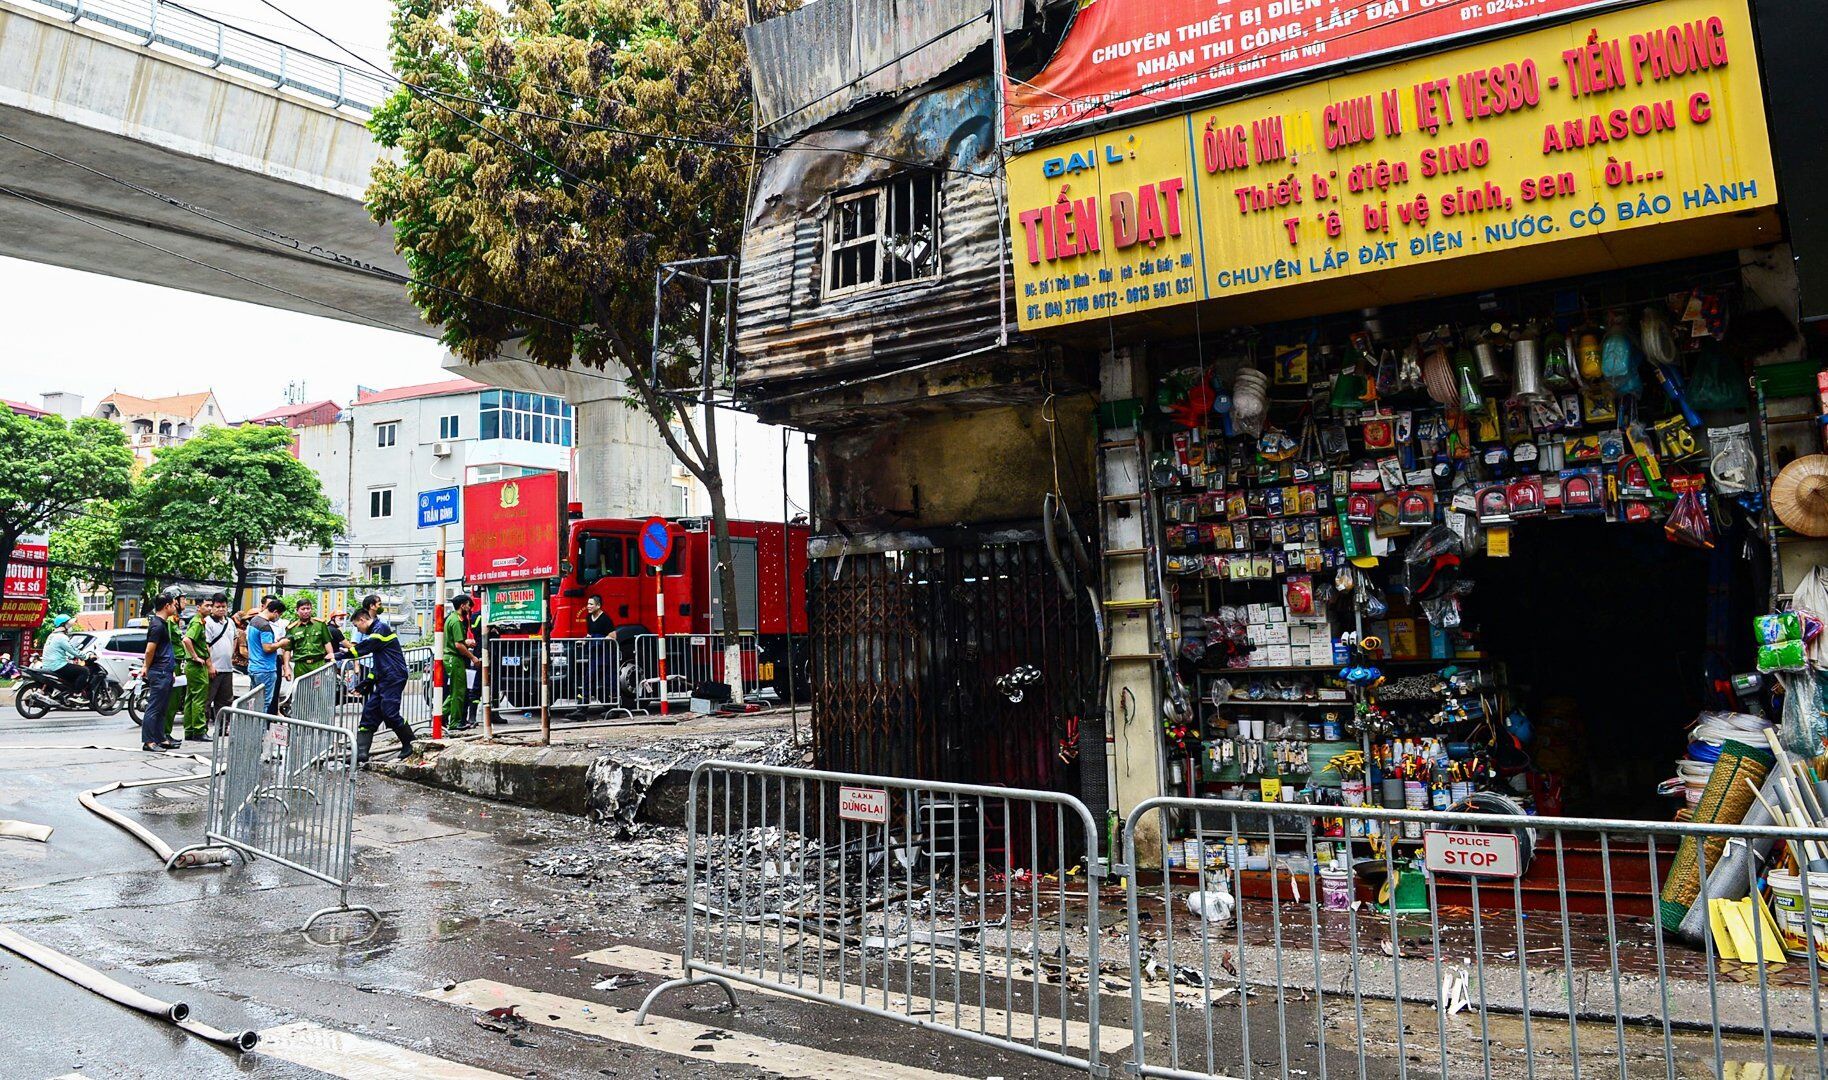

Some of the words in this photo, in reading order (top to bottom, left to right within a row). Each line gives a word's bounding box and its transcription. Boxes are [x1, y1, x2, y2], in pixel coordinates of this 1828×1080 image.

[1091, 32, 1171, 65] CHUYÊN
[1176, 12, 1234, 43] THIẾT
[1240, 7, 1263, 27] BỊ
[1460, 7, 1482, 20] ĐT:
[1136, 50, 1196, 78] NHẬN
[1200, 38, 1235, 61] THI
[1241, 18, 1309, 52] CÔNG,
[1316, 8, 1358, 33] LẮP
[1022, 114, 1041, 126] ĐC:
[1044, 104, 1058, 121] SỐ
[1061, 106, 1068, 116] 1
[1209, 62, 1235, 79] CẦU
[1281, 48, 1299, 62] HÀ
[1303, 42, 1326, 57] NỘI
[1203, 116, 1249, 174] ỐNG
[1458, 58, 1541, 120] VESBO
[1629, 16, 1729, 84] PHONG
[1543, 100, 1676, 155] ANASON
[1043, 150, 1095, 178] ĐẠI
[1235, 173, 1303, 214] Thiết
[1348, 158, 1409, 192] điện
[1420, 138, 1490, 178] SINO
[1019, 184, 1102, 265] TIẾN
[1109, 177, 1185, 250] ĐẠT
[1363, 201, 1389, 233] bị
[1397, 193, 1431, 227] vệ
[1440, 180, 1513, 218] sinh,
[1520, 170, 1576, 201] sen
[1218, 258, 1302, 289] CHUYÊN
[1310, 246, 1350, 274] LẮP
[1358, 241, 1399, 266] ĐẶT
[1409, 231, 1463, 257] ĐIỆN
[1569, 201, 1607, 229] CÓ
[1617, 192, 1672, 222] BẢO
[1683, 179, 1758, 211] HÀNH
[1039, 277, 1050, 295] Số
[423, 506, 439, 524] TRẦN
[436, 492, 451, 503] PHỐ
[1444, 850, 1498, 866] STOP
[1449, 837, 1491, 847] POLICE
